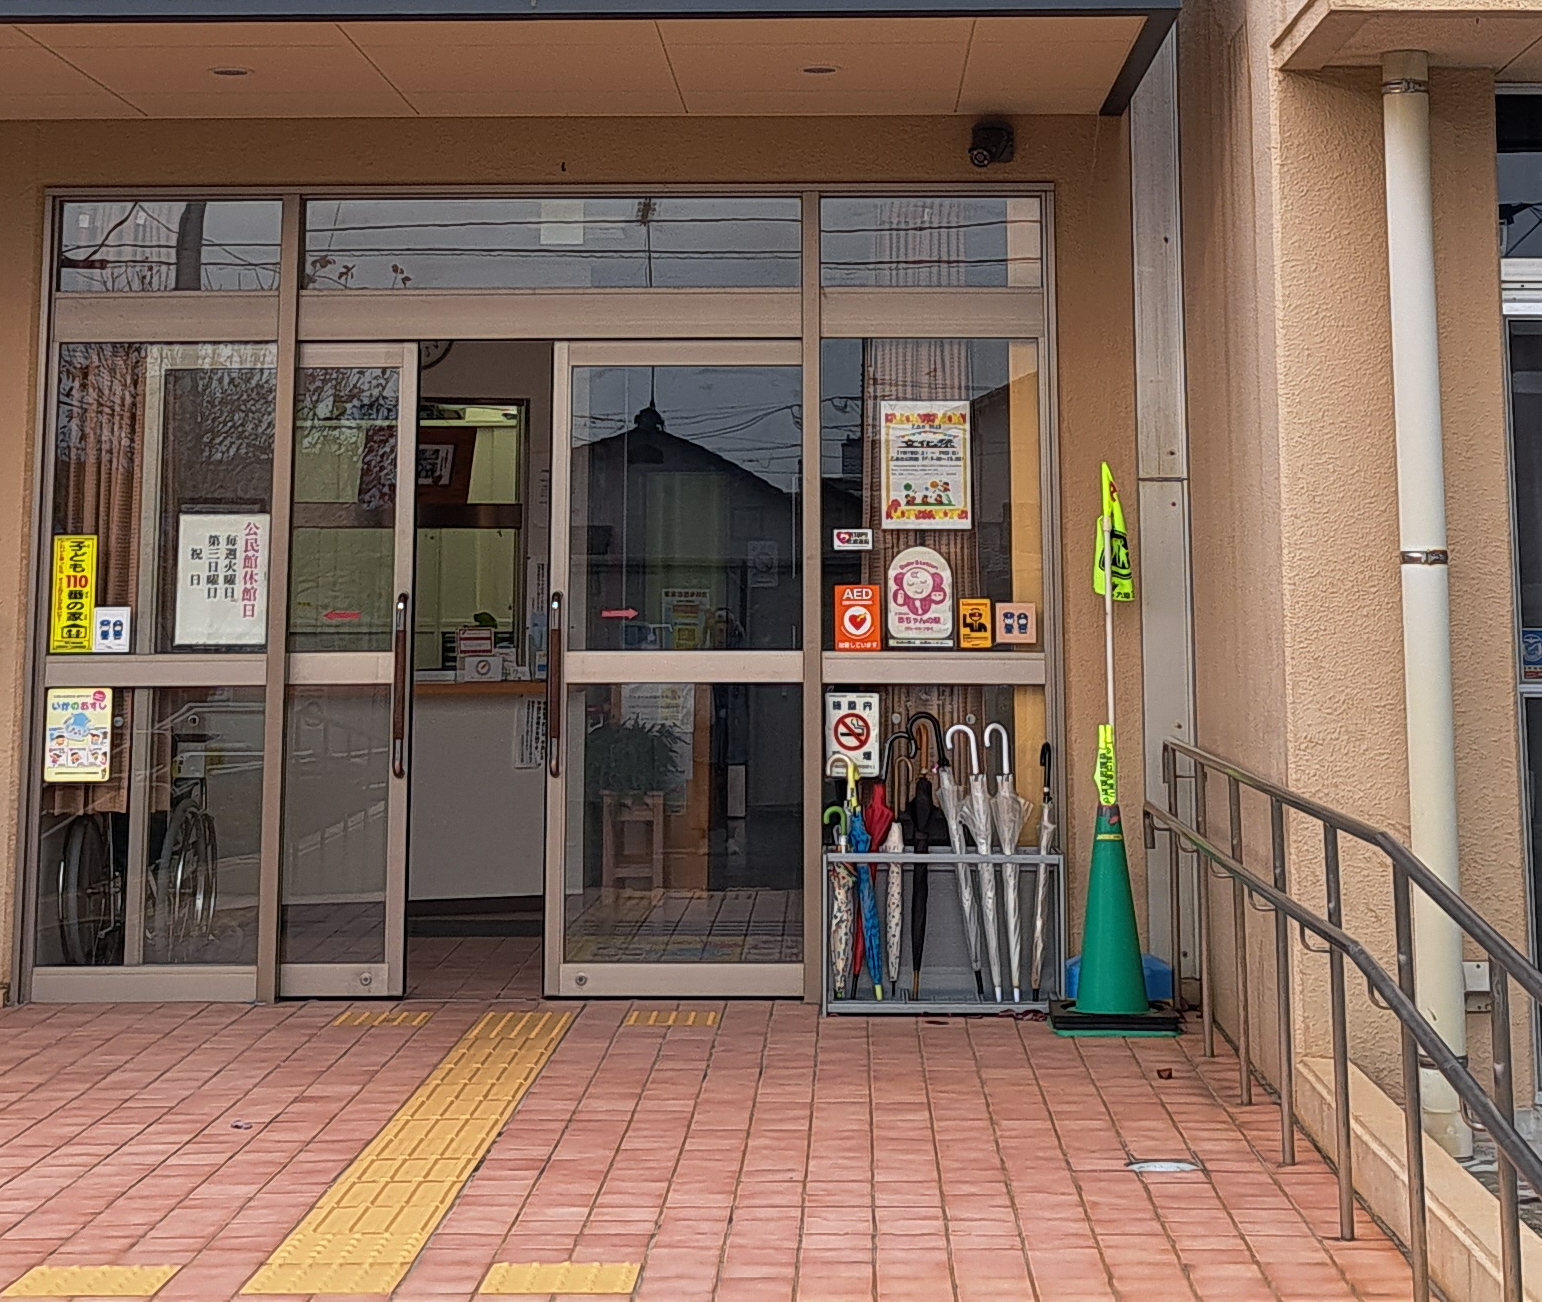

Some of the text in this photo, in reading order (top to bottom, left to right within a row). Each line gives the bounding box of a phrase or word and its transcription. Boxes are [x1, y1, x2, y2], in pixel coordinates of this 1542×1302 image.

[190, 547, 203, 586] 祝日
[206, 534, 221, 599] 第三日曜日
[223, 534, 238, 600] 毎週火曜日
[242, 522, 260, 618] 公民館休館日
[843, 588, 872, 599] AED
[51, 701, 107, 711] いかのおすし
